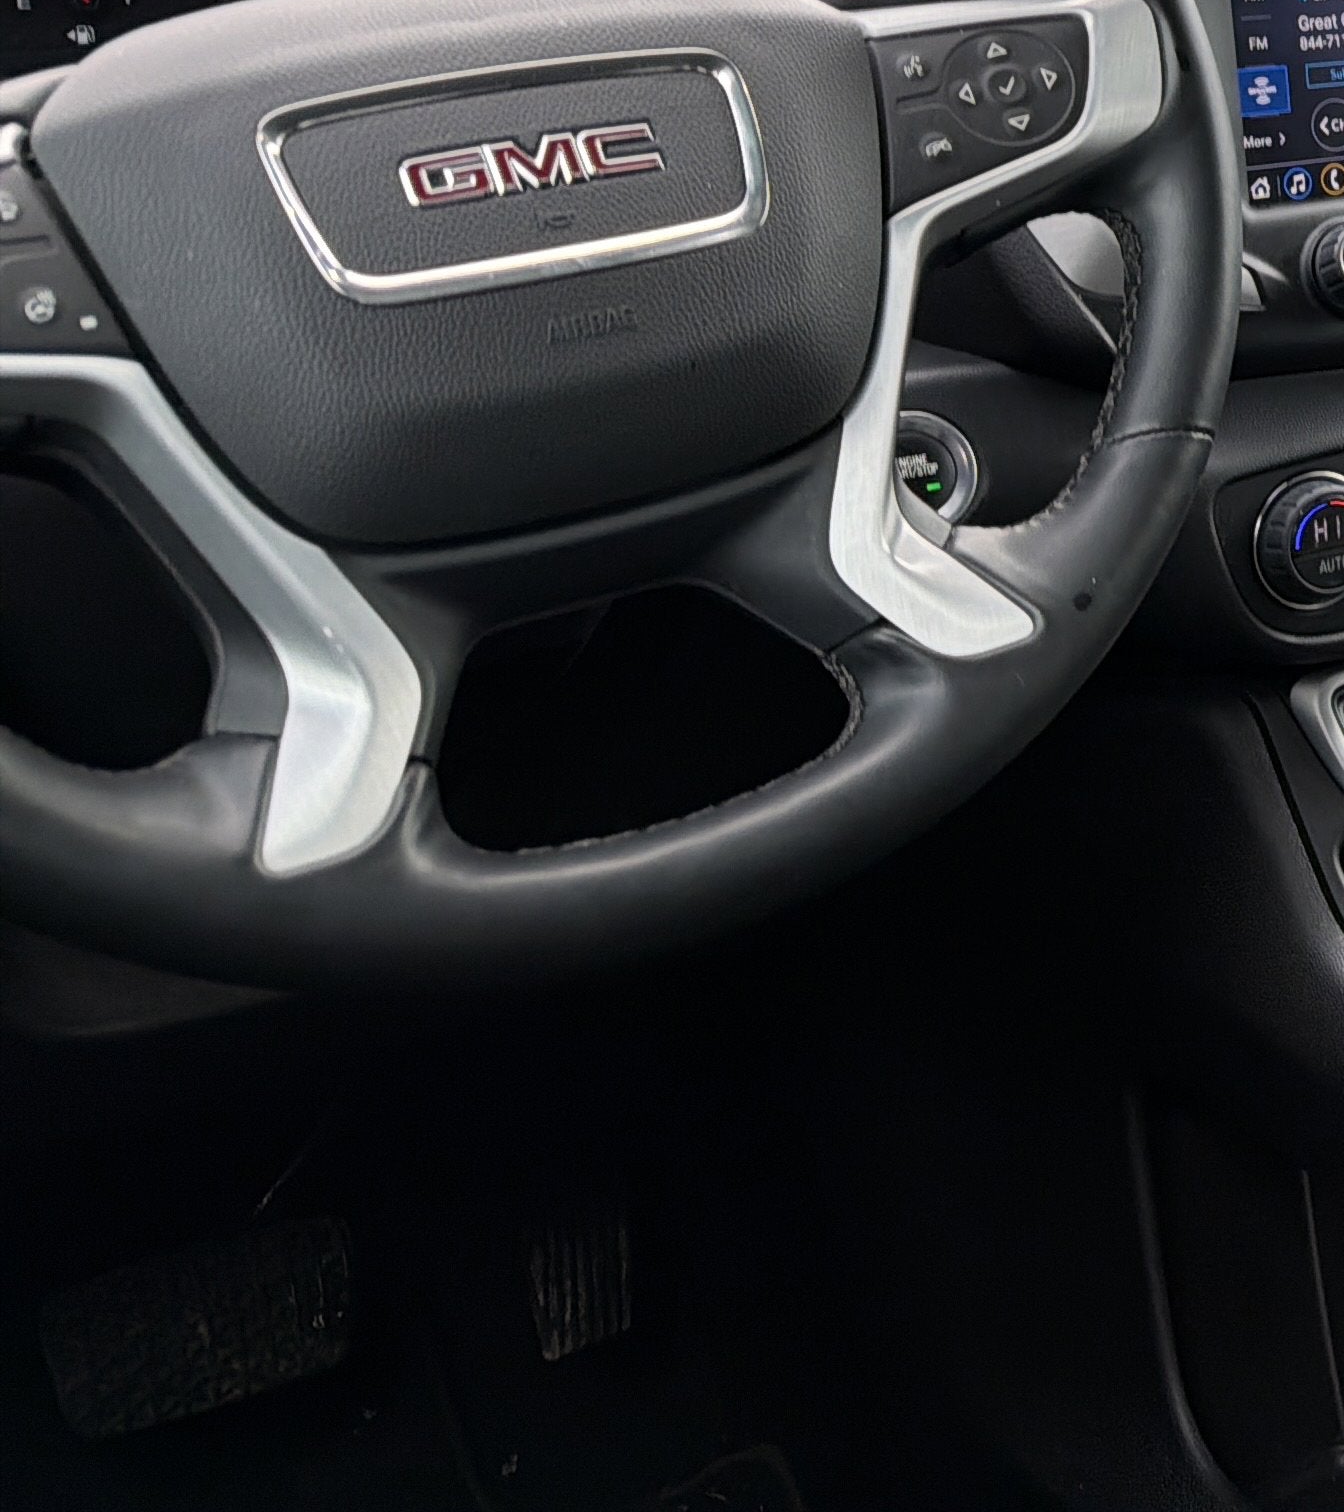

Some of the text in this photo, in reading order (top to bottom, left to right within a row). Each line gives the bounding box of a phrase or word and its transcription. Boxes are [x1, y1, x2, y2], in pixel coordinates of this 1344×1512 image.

[1298, 13, 1338, 32] Great
[1249, 36, 1269, 51] FM
[1243, 134, 1273, 149] More
[399, 122, 666, 207] GMC
